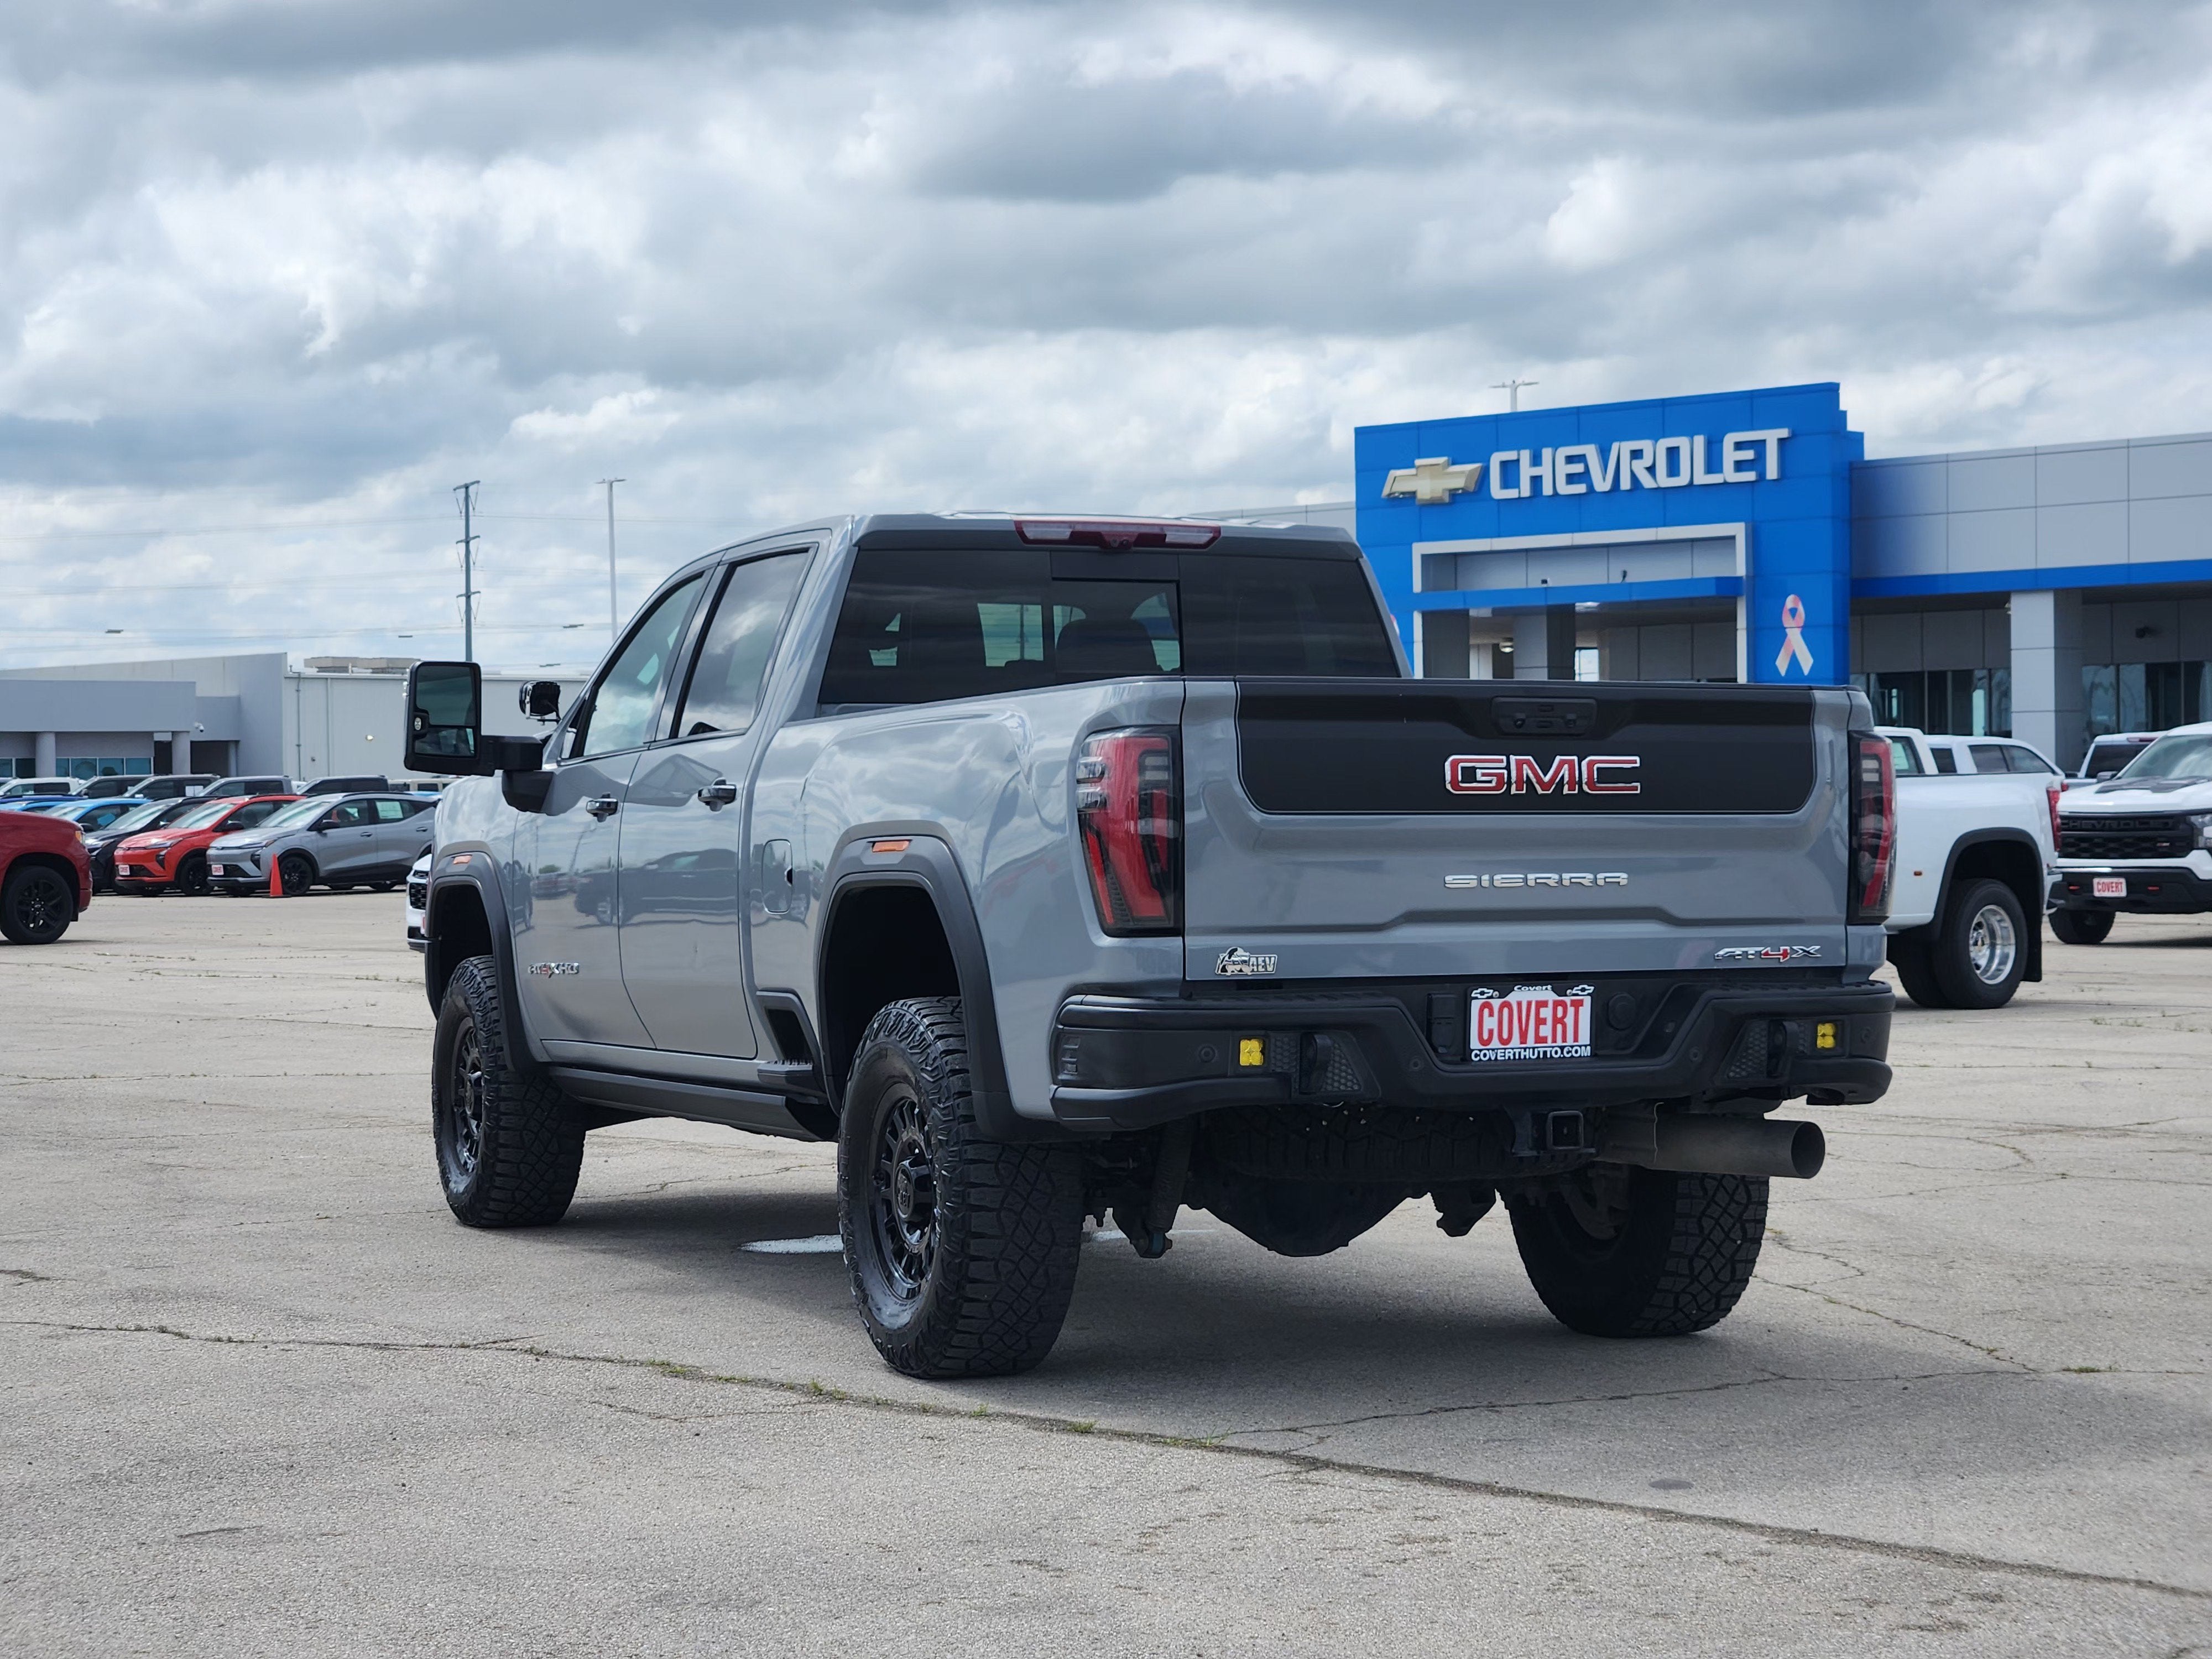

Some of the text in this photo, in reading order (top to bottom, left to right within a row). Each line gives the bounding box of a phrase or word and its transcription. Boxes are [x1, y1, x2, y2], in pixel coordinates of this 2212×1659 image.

[1490, 428, 1791, 499] CHEVROLET
[1445, 754, 1641, 795] GMC
[1444, 873, 1629, 888] SIERRA
[2096, 881, 2123, 893] COVERT
[1714, 946, 1822, 962] AT4X
[1249, 956, 1275, 972] AEV
[1477, 998, 1584, 1047] COVERT
[1470, 1046, 1591, 1061] COVERTHUTTO.COM
